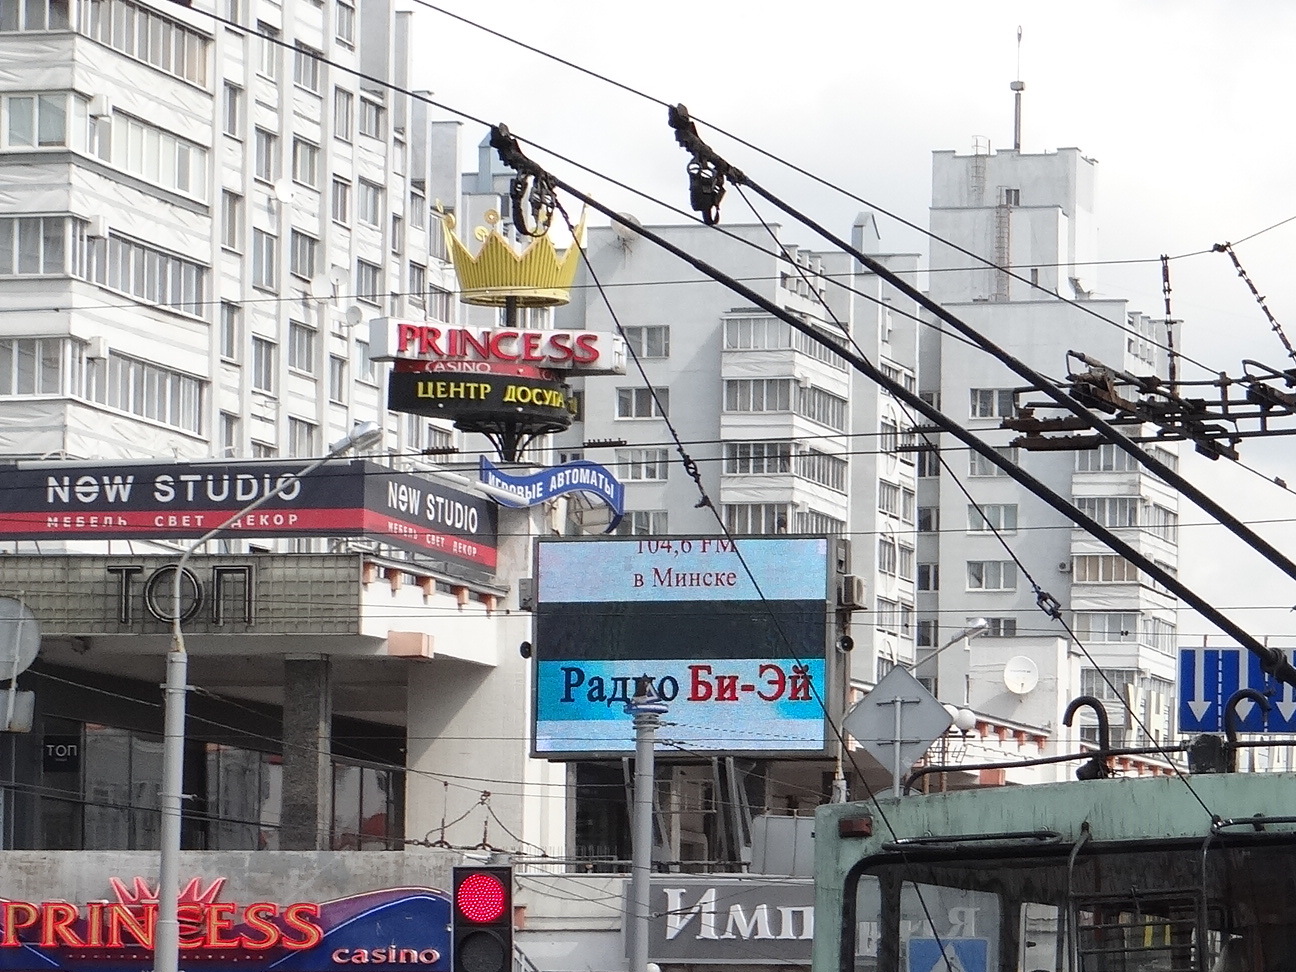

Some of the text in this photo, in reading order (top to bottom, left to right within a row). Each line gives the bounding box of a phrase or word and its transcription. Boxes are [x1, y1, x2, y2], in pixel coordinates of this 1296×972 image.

[398, 323, 600, 363] PRINCESS
[417, 381, 491, 399] ЦЕНТР
[154, 473, 300, 502] STUDIO
[549, 468, 615, 498] АВТОМАТЫ
[47, 516, 127, 528] МЕБЕЛЬ
[154, 515, 204, 527] СВЕТ
[427, 493, 478, 534] STUDIO
[652, 567, 737, 588] Минске
[107, 563, 257, 626] ТОП
[688, 664, 813, 701] Би-Эй
[332, 943, 440, 964] casino
